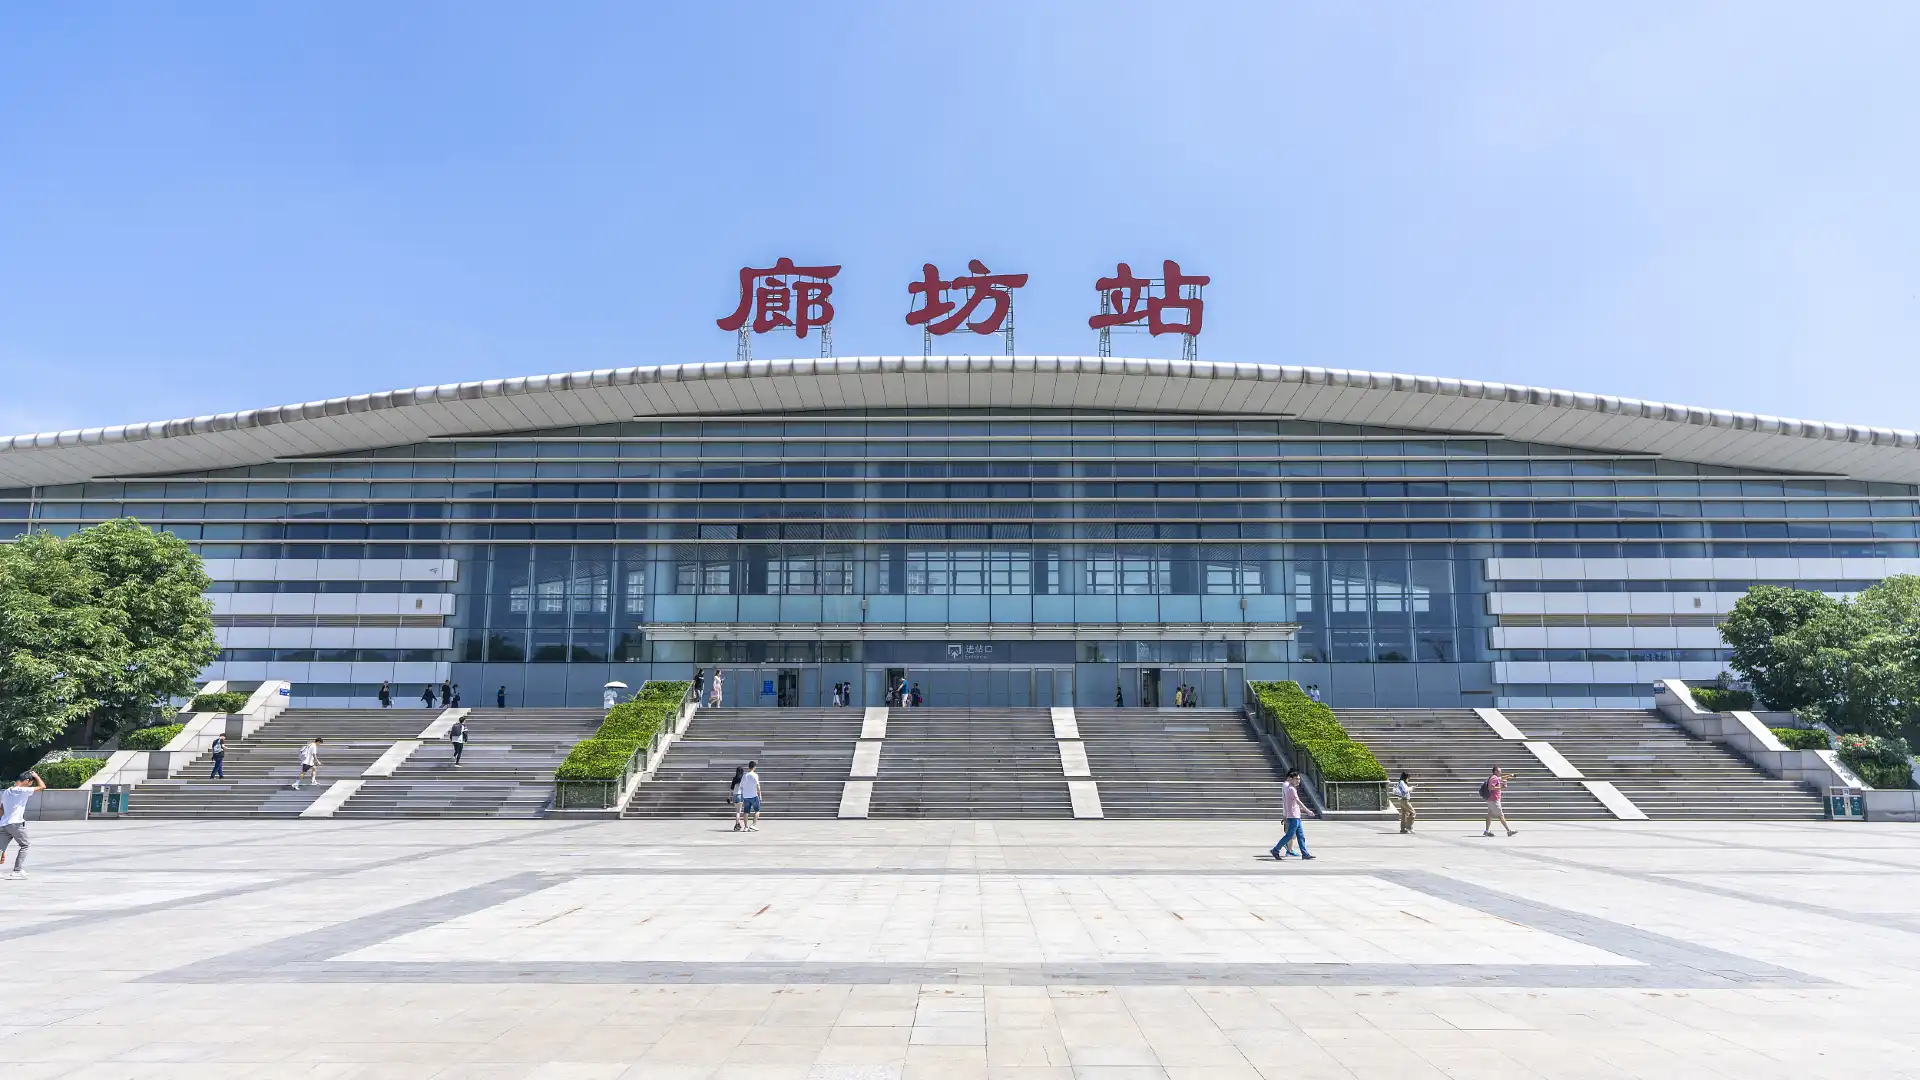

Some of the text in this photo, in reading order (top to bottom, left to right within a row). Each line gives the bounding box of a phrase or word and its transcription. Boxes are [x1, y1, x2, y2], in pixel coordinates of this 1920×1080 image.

[716, 257, 1211, 338] 廊坊站
[965, 644, 993, 654] 进站口
